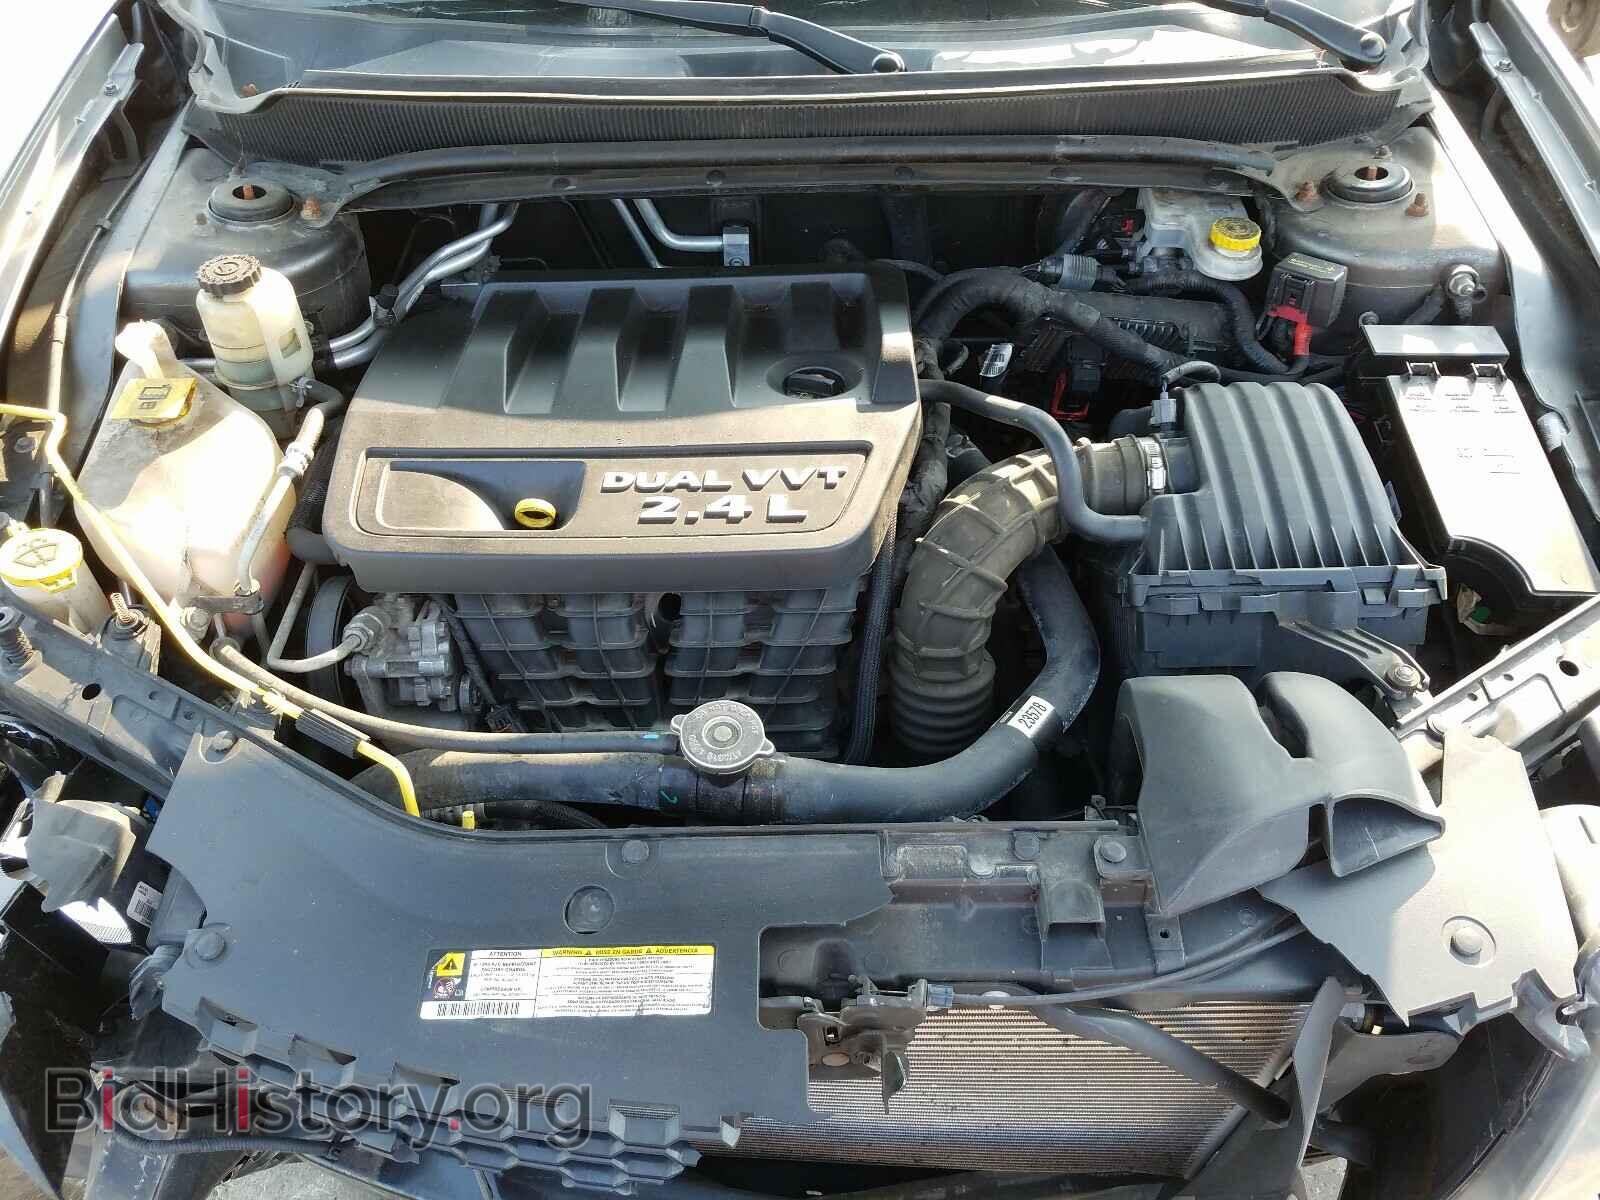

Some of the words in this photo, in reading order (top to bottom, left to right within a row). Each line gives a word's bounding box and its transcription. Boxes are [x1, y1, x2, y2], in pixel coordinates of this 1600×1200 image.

[600, 471, 732, 493] DUAL
[741, 467, 848, 491] VVT
[637, 494, 753, 525] 2.4
[765, 494, 808, 524] L
[1018, 702, 1047, 729] 23578
